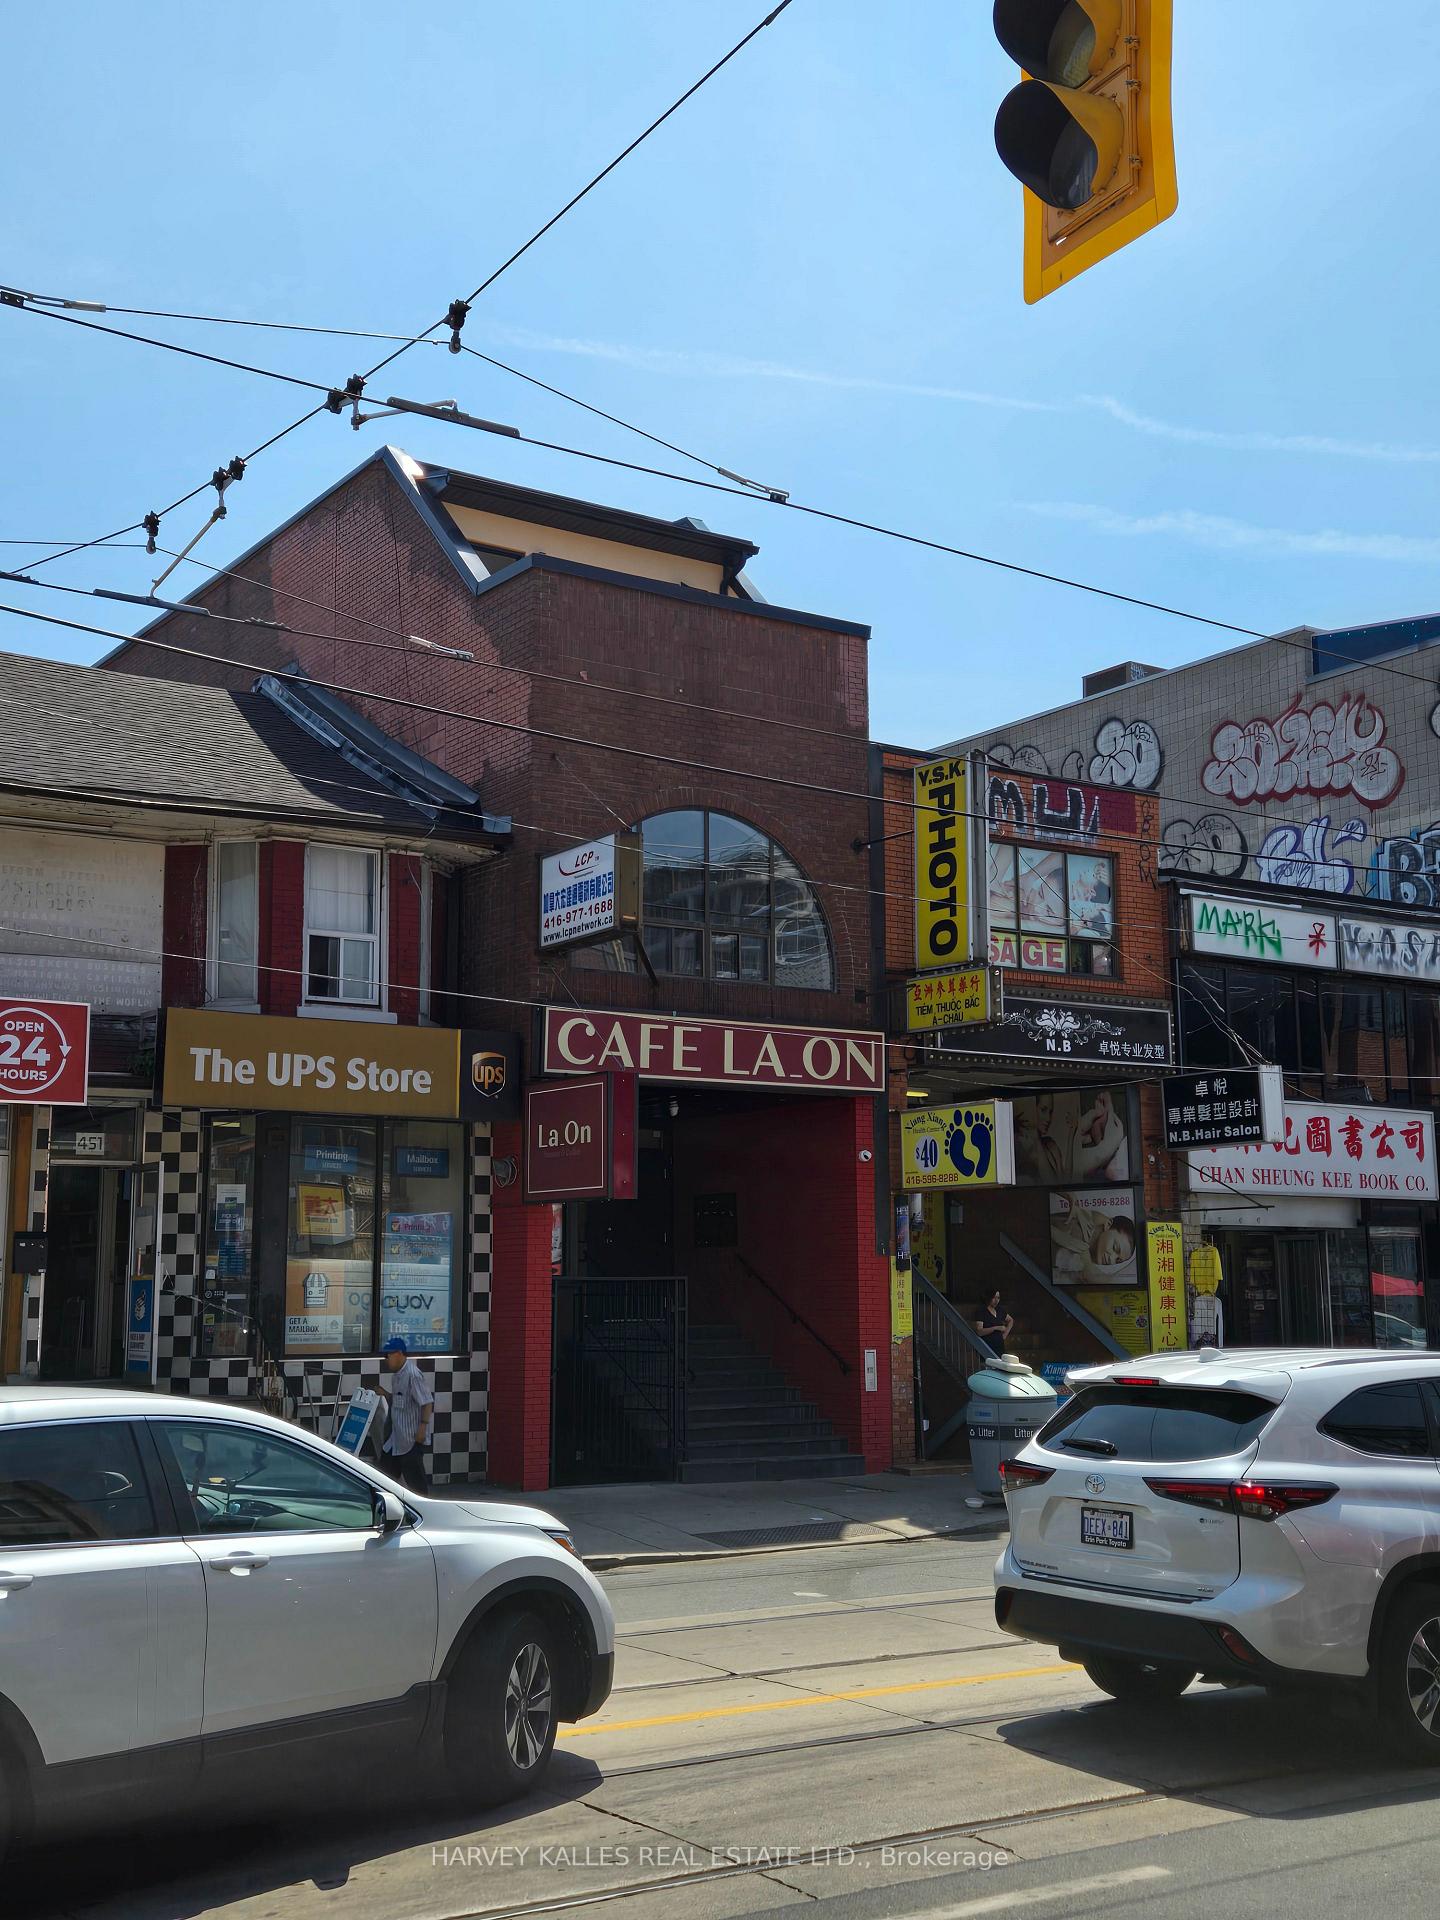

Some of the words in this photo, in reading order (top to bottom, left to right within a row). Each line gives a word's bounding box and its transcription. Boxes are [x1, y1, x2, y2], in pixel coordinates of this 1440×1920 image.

[918, 760, 966, 787] Y.S.K.
[575, 851, 594, 868] LCP
[928, 782, 958, 957] PHOTO
[544, 898, 613, 929] 416-977-1688
[543, 915, 613, 943] www.lcpnetwork.ca
[4, 1020, 44, 1033] OPEN
[0, 1034, 50, 1067] 24
[557, 1017, 702, 1072] CAFE
[1046, 1038, 1072, 1053] N.B
[1099, 1040, 1165, 1060] 卓悦专业发型
[0, 1068, 48, 1081] HOURS
[190, 1047, 256, 1085] The
[267, 1052, 336, 1089] UPS
[346, 1058, 432, 1094] Store
[474, 1066, 504, 1090] ups
[1168, 1098, 1259, 1125] 專業髮型設計
[1169, 1127, 1222, 1143] N.B.Hair
[1224, 1124, 1260, 1139] Salon
[77, 1136, 103, 1151] 451
[316, 1149, 348, 1162] Printing
[407, 1154, 439, 1165] Mailbox
[915, 1139, 938, 1168] $40
[1199, 1165, 1246, 1184] CHAN
[1252, 1168, 1315, 1187] SHEUNG
[1322, 1171, 1352, 1189] KEE
[1359, 1173, 1400, 1190] BOOK
[1405, 1175, 1429, 1192] CO.
[1156, 1239, 1178, 1347] 湘湘健康中心
[288, 1325, 320, 1333] MAILBOX
[390, 1320, 409, 1333] The
[415, 1334, 445, 1346] Store
[978, 1426, 995, 1438] Litter
[1014, 1428, 1034, 1438] Litter
[1112, 1520, 1128, 1539] 841
